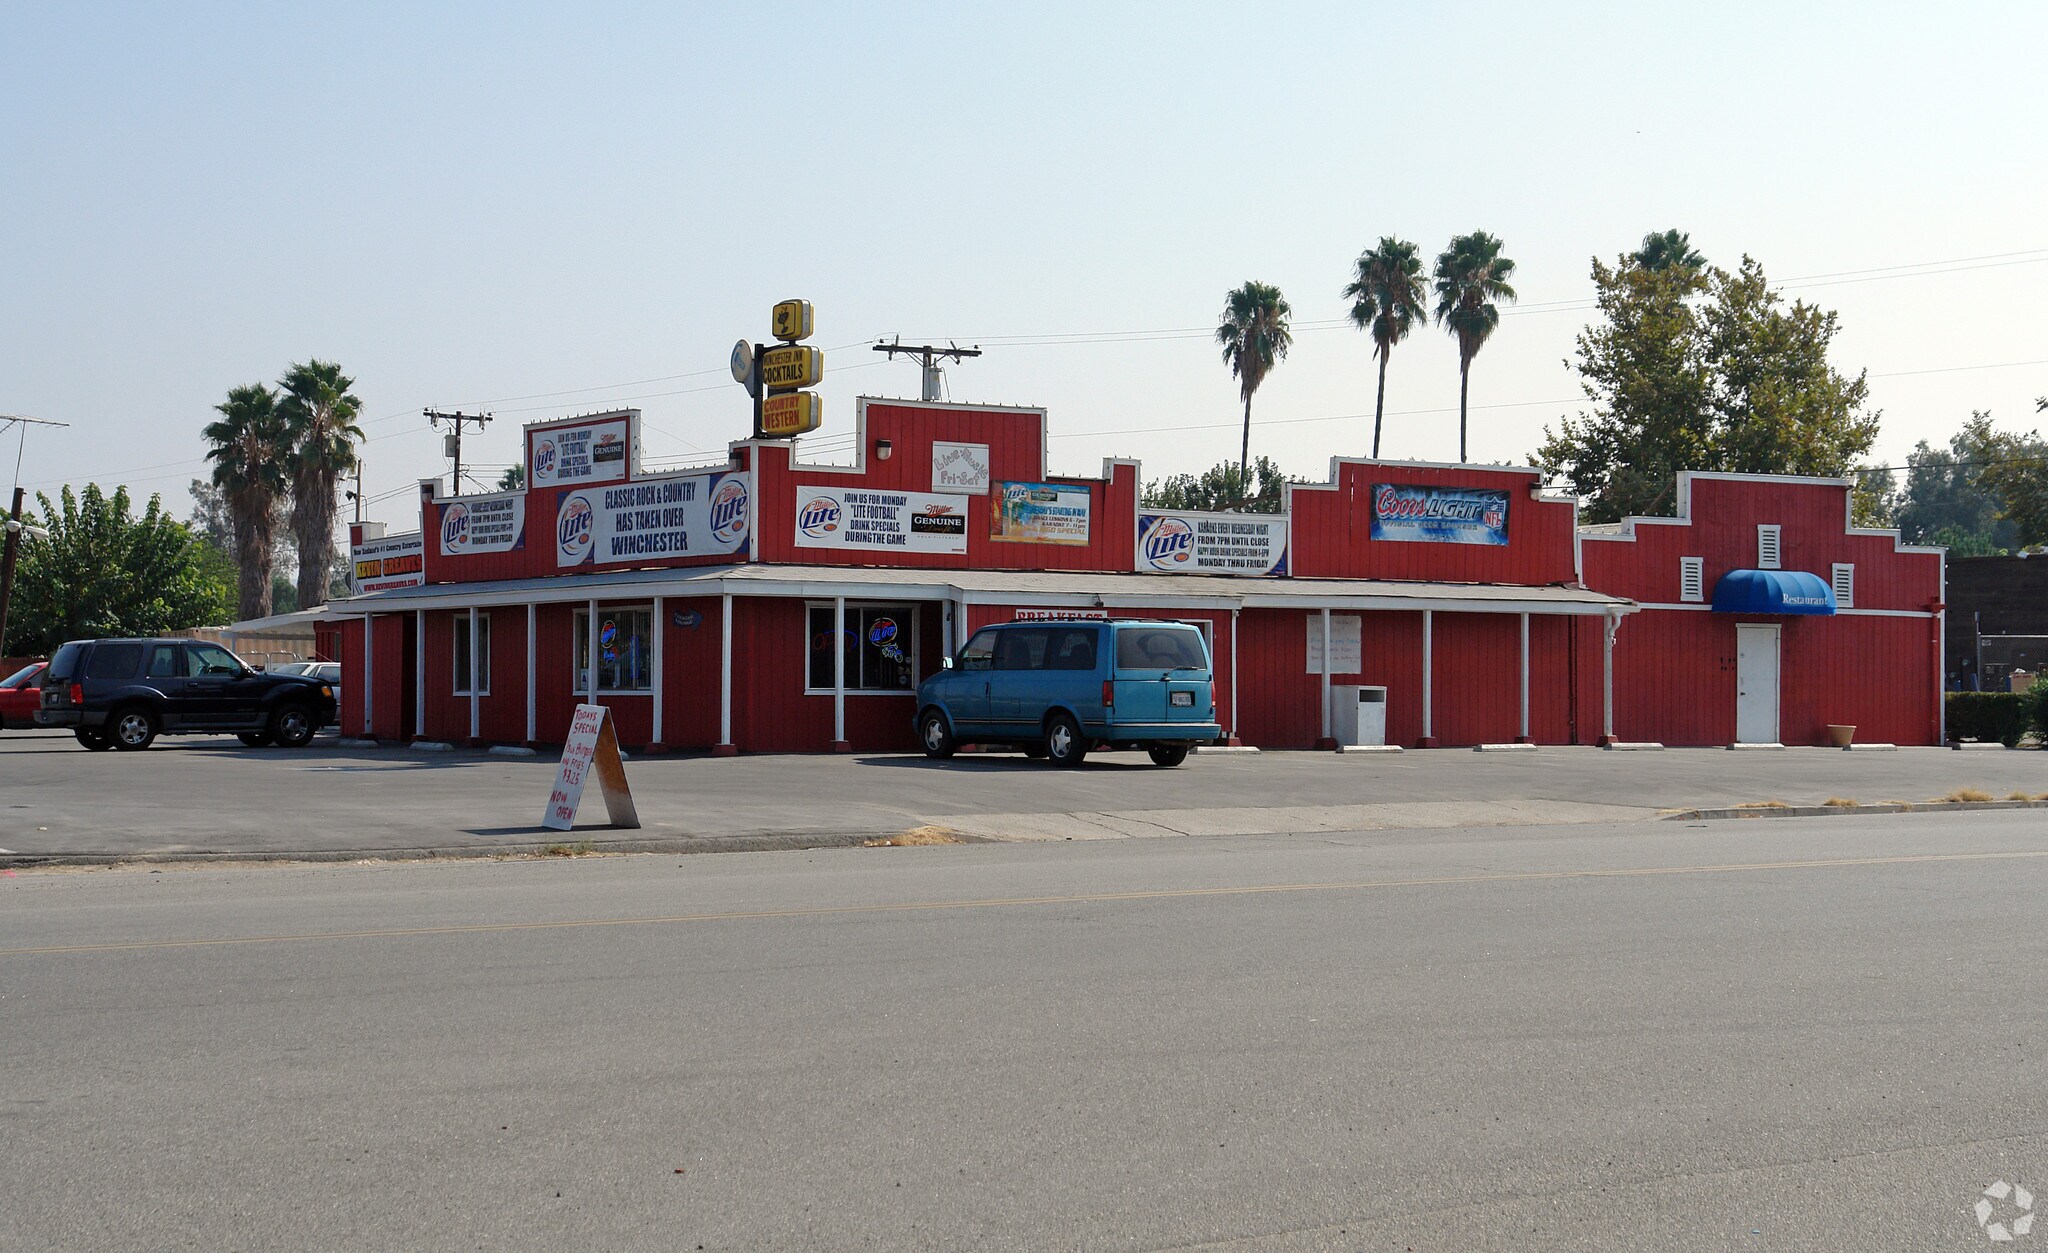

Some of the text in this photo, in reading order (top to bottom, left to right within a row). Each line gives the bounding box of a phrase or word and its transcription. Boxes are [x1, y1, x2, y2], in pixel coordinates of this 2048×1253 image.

[794, 351, 803, 363] INN
[764, 364, 803, 383] COCKTAILS
[764, 396, 800, 413] COUNTRY
[764, 410, 800, 429] WESTERN
[594, 445, 622, 455] GENUINE
[536, 449, 555, 471] Lite
[941, 470, 980, 485] Fri-Sat
[605, 481, 696, 510] CLASSIC ROCK & COUNTRY
[844, 493, 907, 506] JOIN US FOR MONDAY
[811, 501, 836, 511] Miller
[851, 504, 899, 520] "LITE FOOTBALL"
[925, 504, 954, 518] Miller
[1376, 488, 1483, 520] Coors LIGHT
[616, 507, 684, 532] HAS TAKEN OVER
[712, 494, 748, 533] Lite
[801, 507, 841, 530] Lite
[914, 516, 962, 526] GENUINE
[1485, 511, 1502, 527] NFL
[446, 515, 469, 543] Lite
[561, 509, 593, 546] Lite
[850, 520, 900, 533] DRINK SPECIALS
[1160, 523, 1186, 537] Miller
[611, 531, 688, 556] WINCHESTER
[845, 531, 906, 545] DURING THE GAME
[1198, 536, 1269, 546] FROM 7PM UNTIL CLOSE
[1149, 532, 1194, 561] Lite
[356, 559, 381, 579] KEVIN
[383, 554, 422, 577] GREAVES
[1198, 558, 1269, 568] MONDAY THRU FRIDAY
[1782, 594, 1828, 606] Restaurant
[573, 722, 598, 735] SPECIAL
[550, 790, 568, 803] NOW
[556, 806, 573, 820] OPEN
